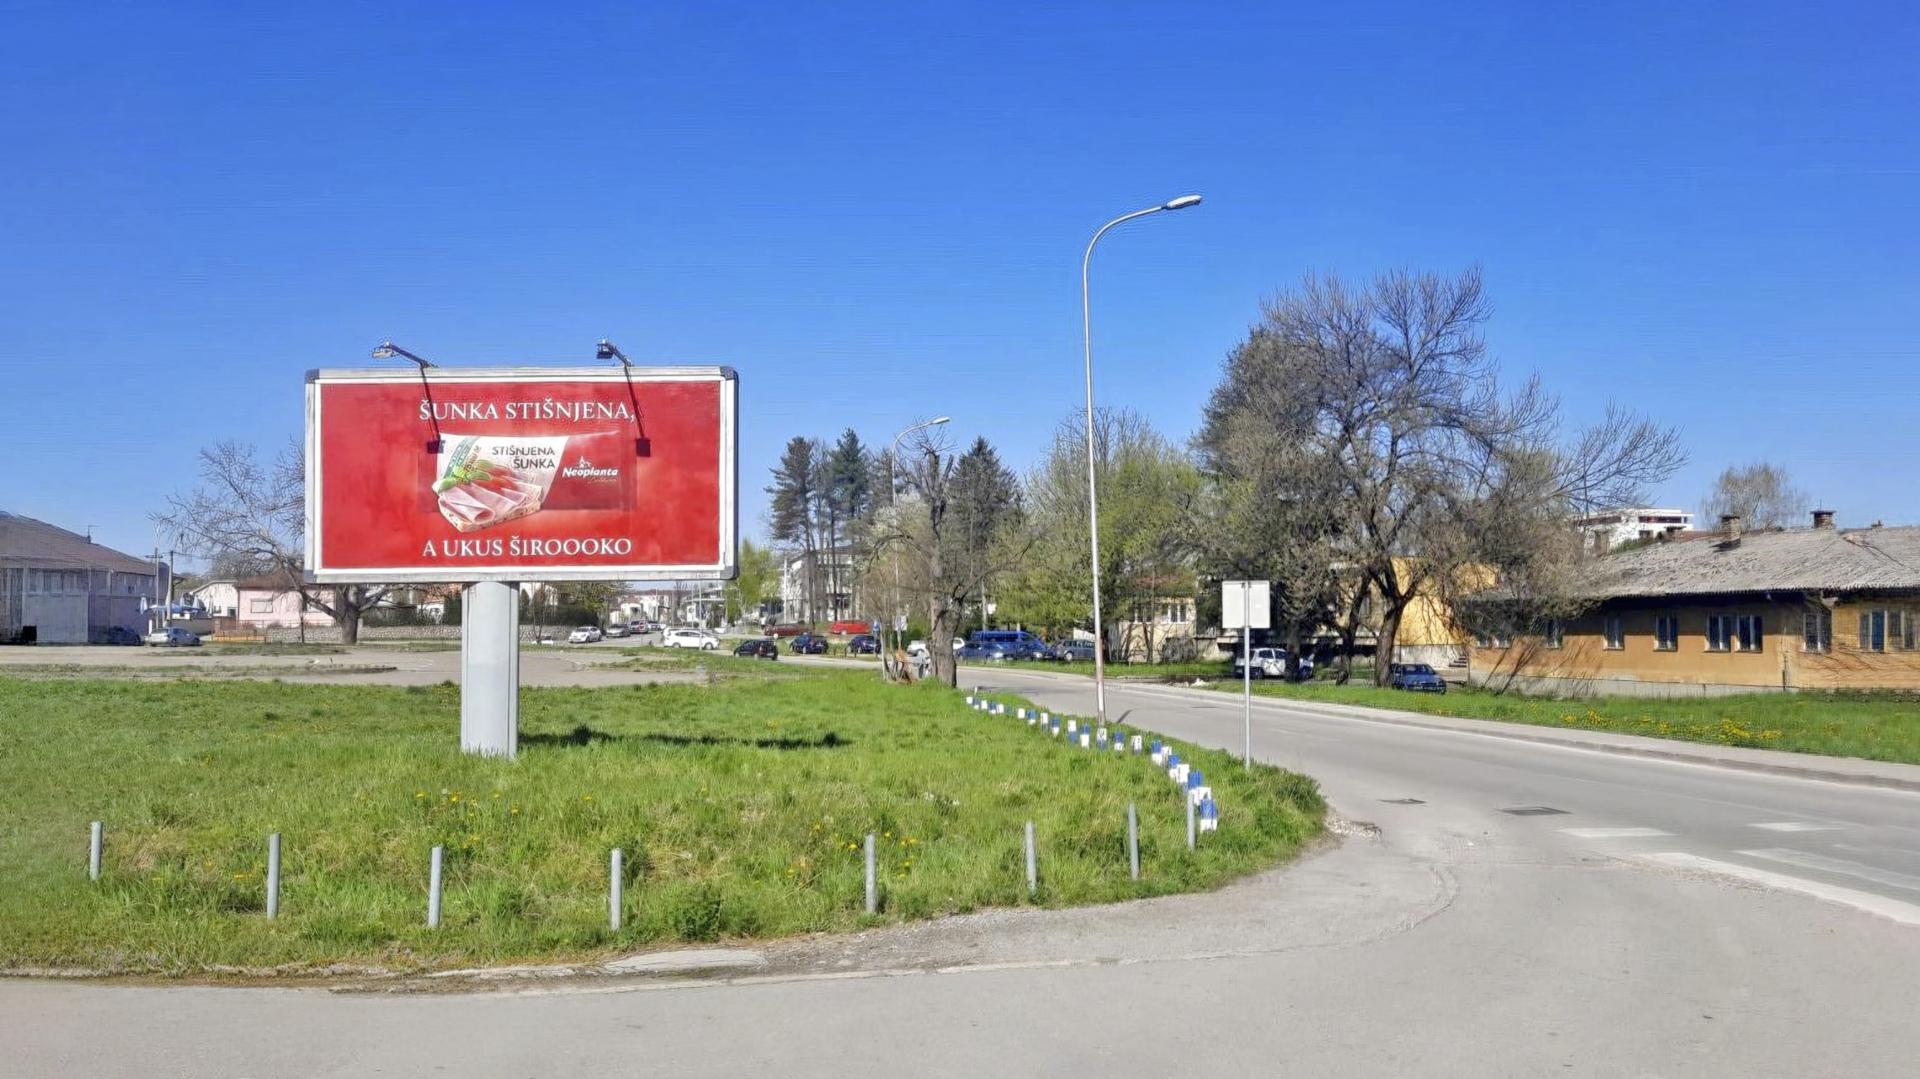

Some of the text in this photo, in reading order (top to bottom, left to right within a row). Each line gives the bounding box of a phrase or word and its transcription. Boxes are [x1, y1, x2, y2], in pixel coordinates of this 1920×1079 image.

[419, 398, 635, 422] ŠUNKA STIŠNJENA,
[492, 445, 555, 456] STIŠNJENA
[513, 456, 555, 469] ŠUNKA
[562, 467, 618, 478] Neoplanta
[423, 536, 632, 557] A UKUS ŠIROOOKO
